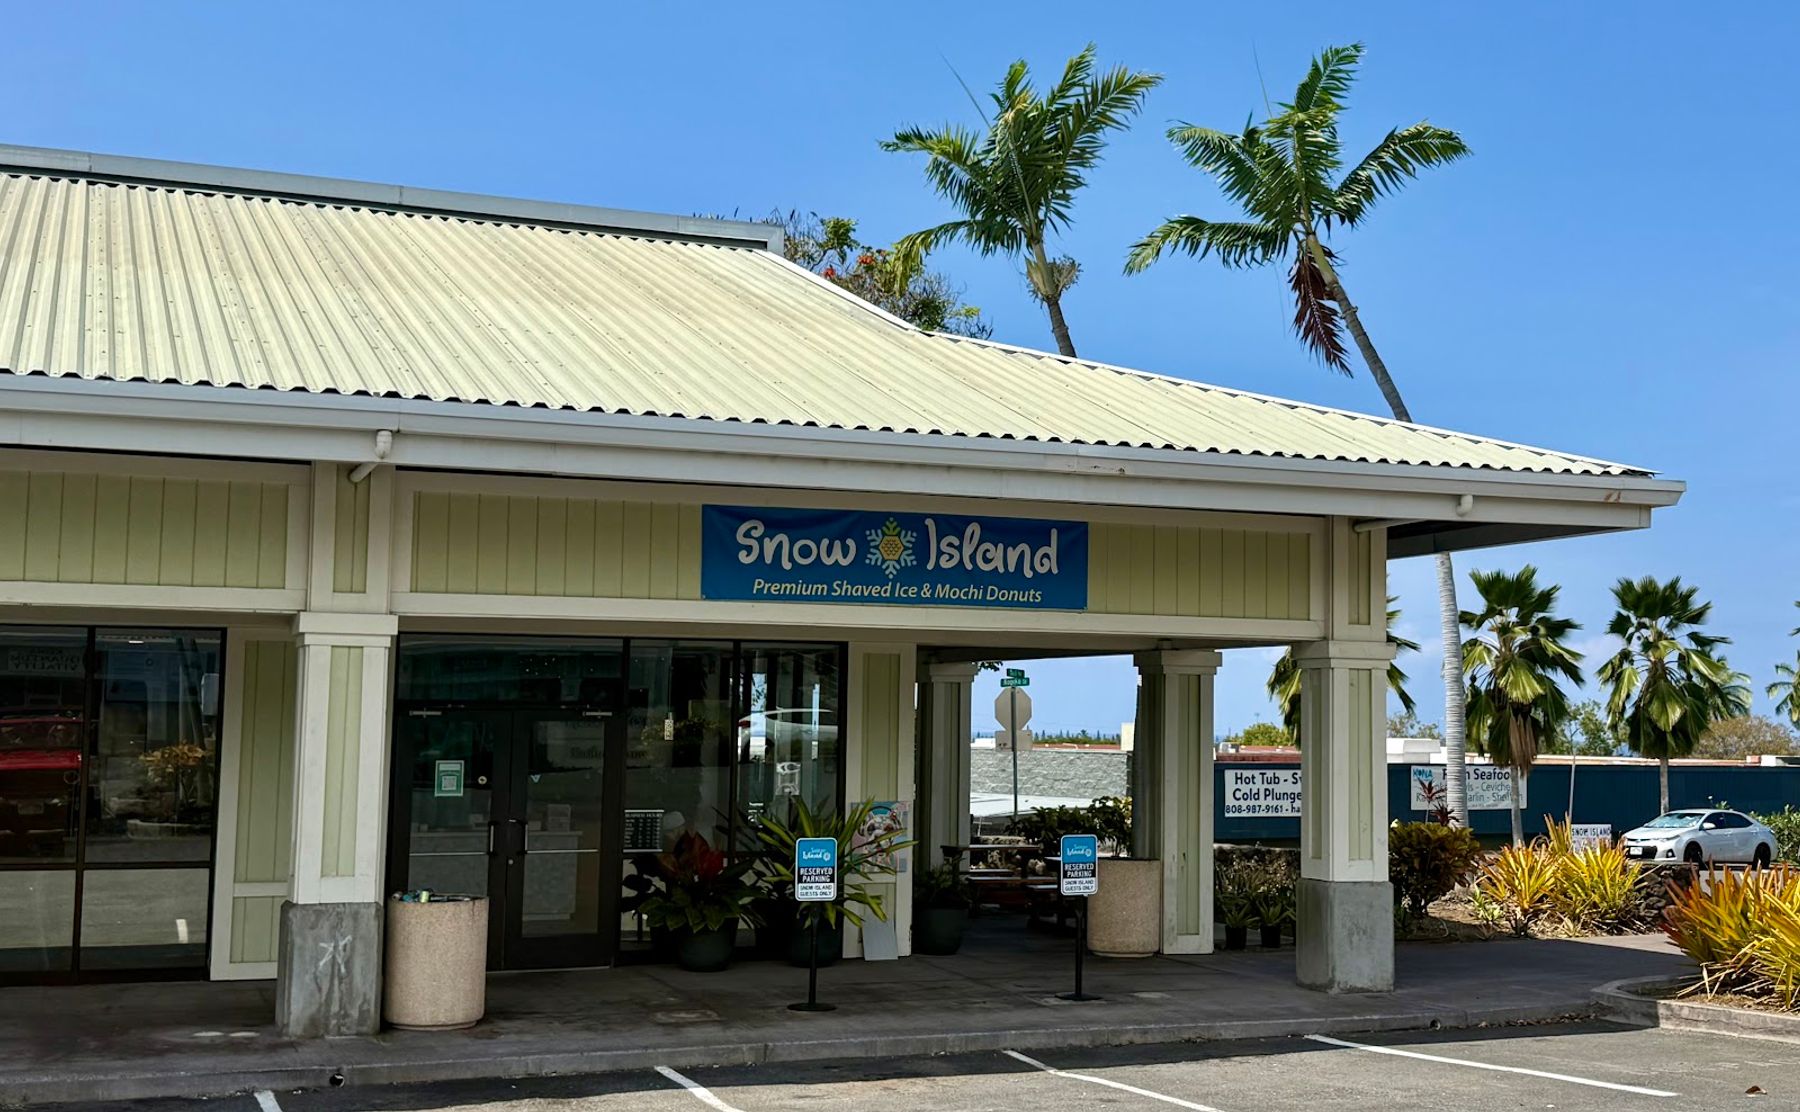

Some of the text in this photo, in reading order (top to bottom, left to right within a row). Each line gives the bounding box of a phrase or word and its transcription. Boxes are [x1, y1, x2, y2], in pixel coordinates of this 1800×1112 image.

[736, 518, 1059, 578] Snow Island
[753, 579, 1043, 602] Premium Shaved Ice & Mochi Donuts
[1235, 772, 1256, 785] Hot
[1259, 772, 1280, 785] Tub
[1474, 768, 1511, 780] Seafoo
[1233, 788, 1260, 801] Cold
[1225, 804, 1283, 814] 808-987-9161
[800, 867, 833, 875] RESERVED
[1065, 863, 1094, 871] RESERVED
